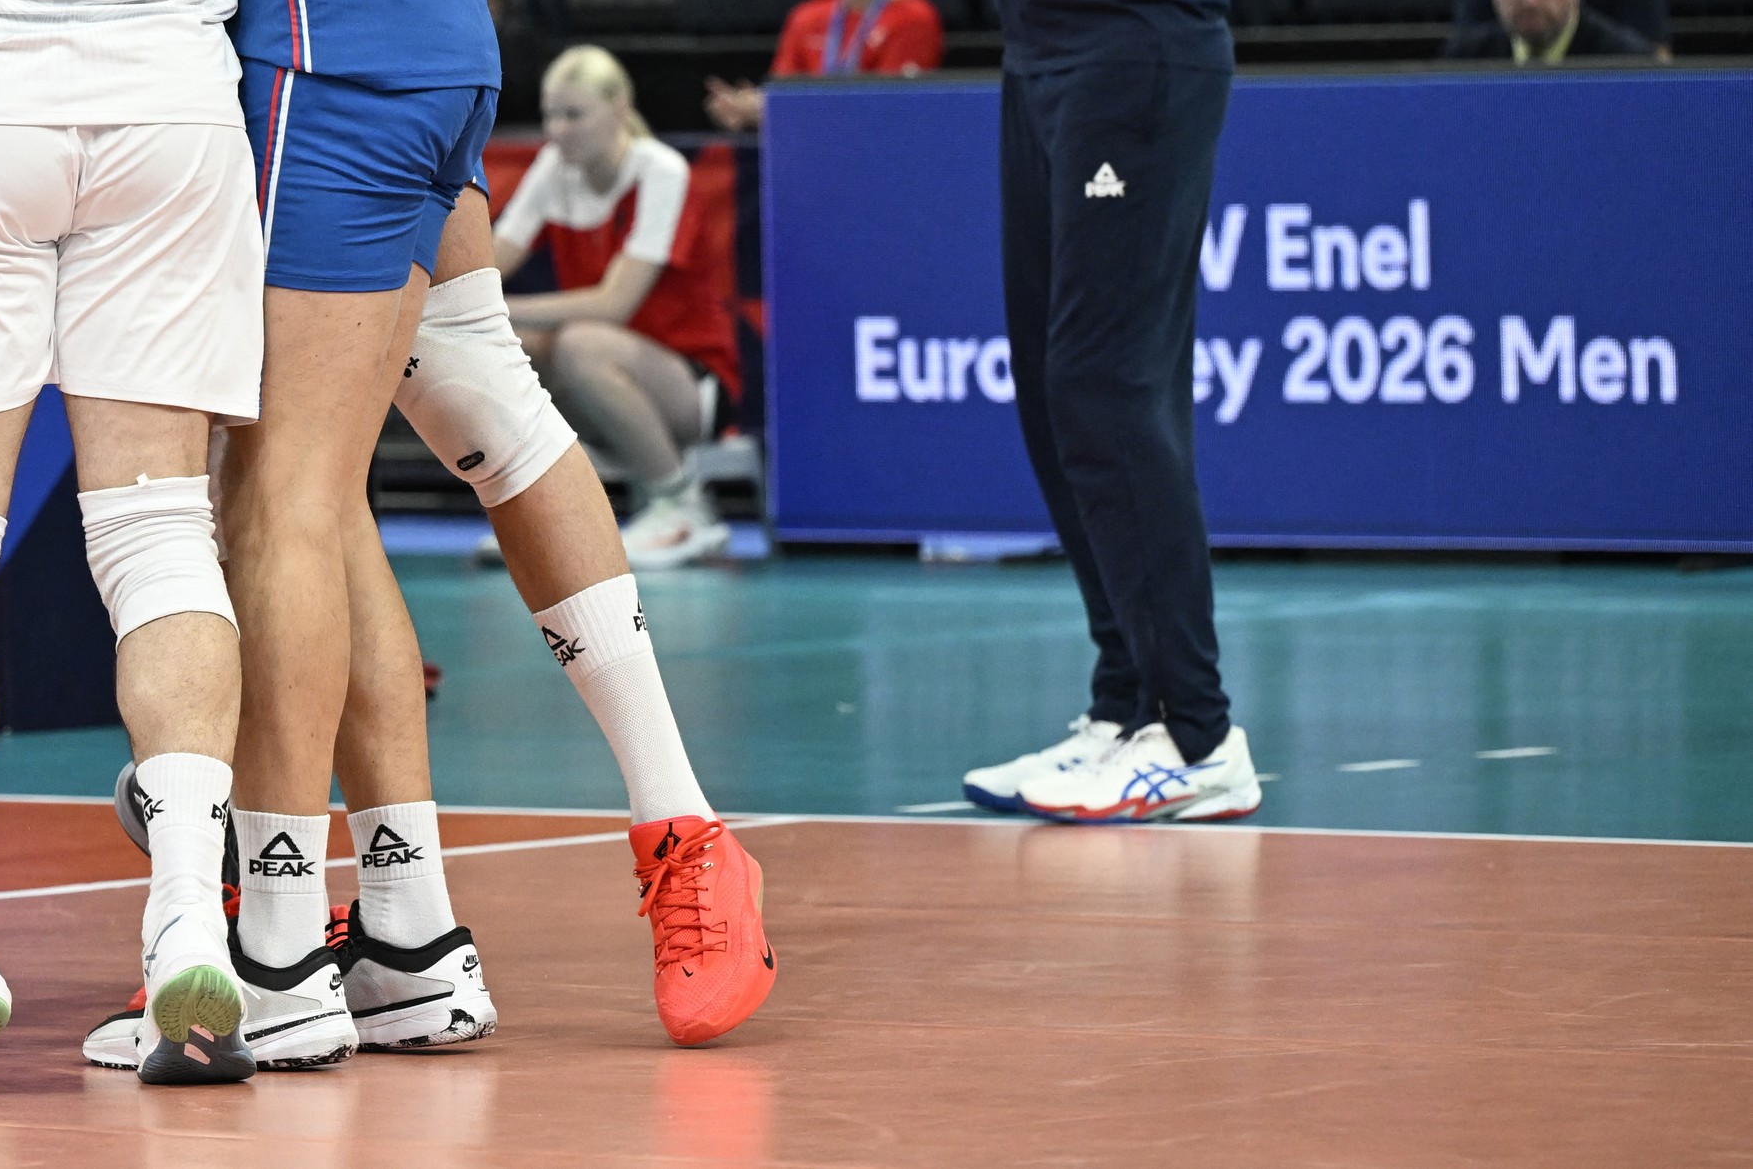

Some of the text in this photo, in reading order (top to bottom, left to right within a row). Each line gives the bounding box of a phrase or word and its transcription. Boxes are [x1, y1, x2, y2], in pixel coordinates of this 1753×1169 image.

[1265, 196, 1432, 292] Enel
[1281, 315, 1476, 404] 2026
[1499, 314, 1679, 405] Men
[248, 858, 316, 877] PEAK
[361, 846, 425, 868] PEAK
